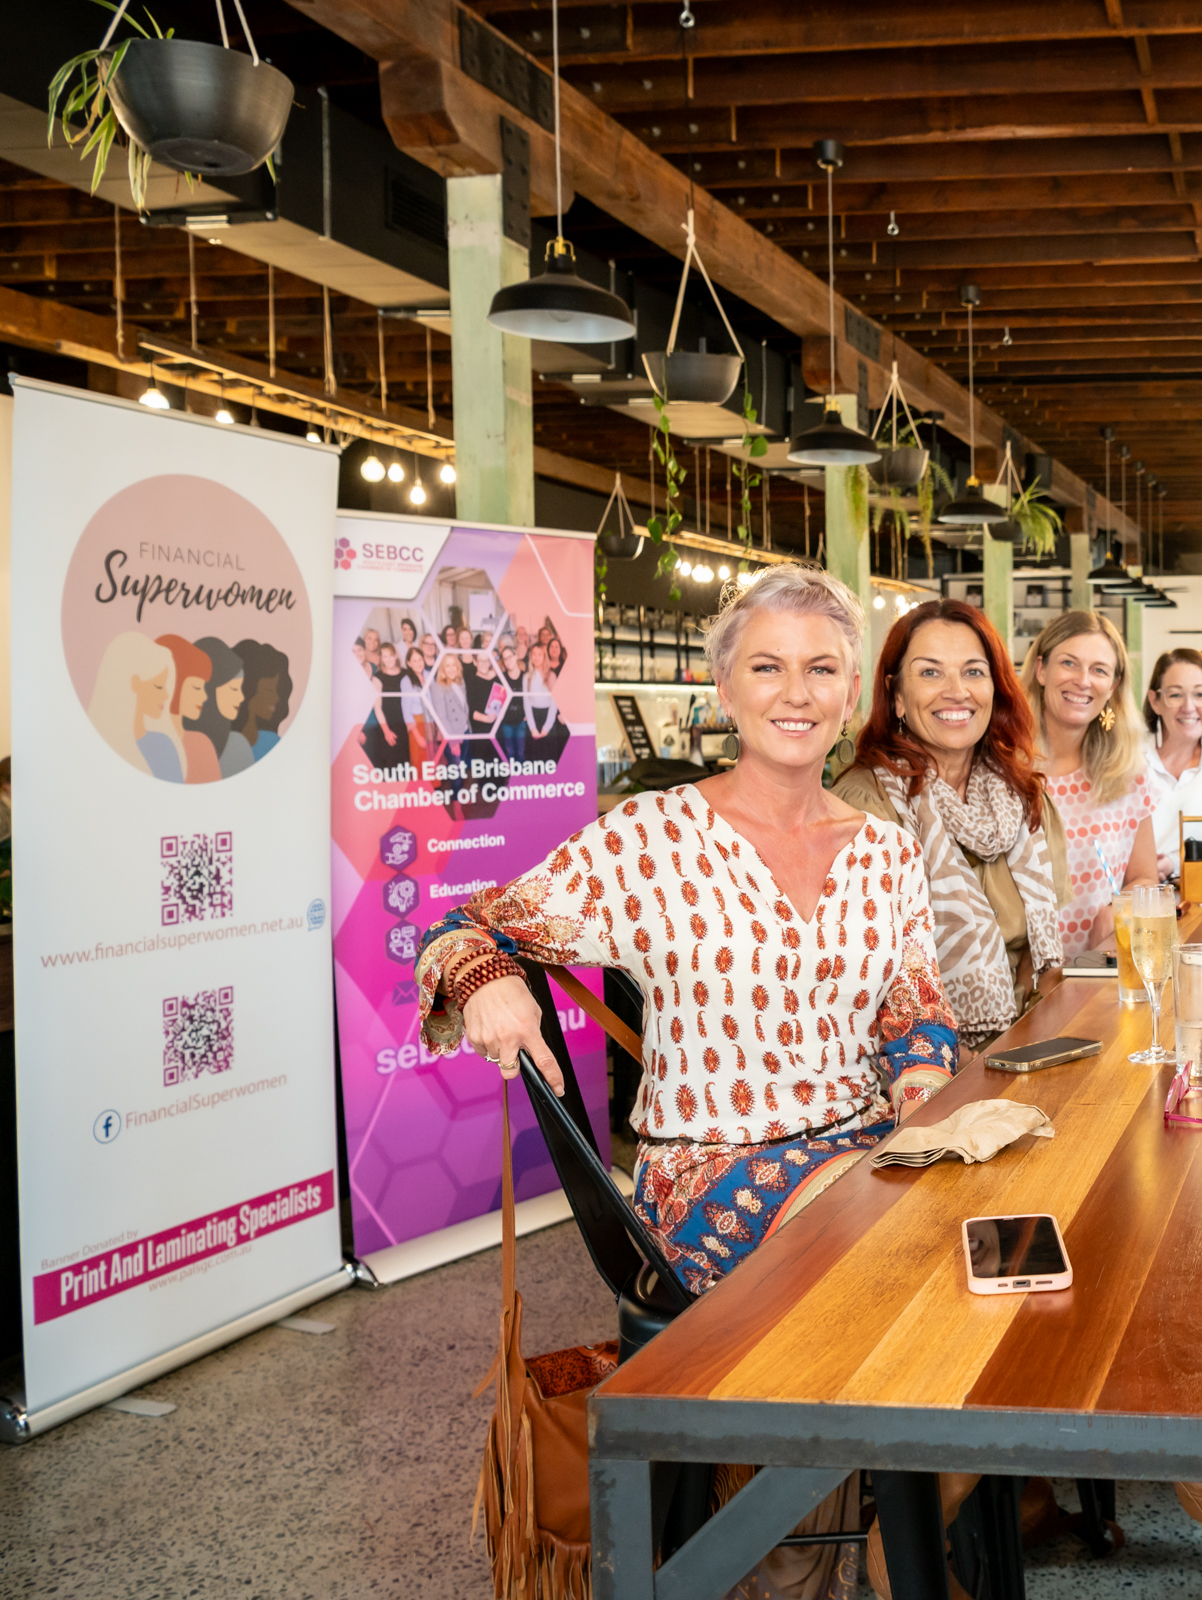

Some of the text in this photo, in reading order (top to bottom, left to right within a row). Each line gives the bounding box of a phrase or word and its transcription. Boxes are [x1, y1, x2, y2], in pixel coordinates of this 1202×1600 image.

[139, 541, 246, 572] FINANCIAL
[362, 543, 424, 562] SEBCC
[94, 549, 296, 623] Superwomen
[352, 757, 557, 785] South East Brisbane
[354, 781, 586, 811] Chamber of Commerce
[427, 833, 505, 853] Connection
[429, 878, 498, 899] Education
[40, 914, 304, 968] www.financialsuperwomen.net.au
[125, 1073, 288, 1129] FinancialSuperwomen
[41, 1227, 139, 1270] Banner Donated by
[60, 1184, 322, 1307] Print And Laminating Specialists
[147, 1244, 253, 1293] www.palsgc.com.au
